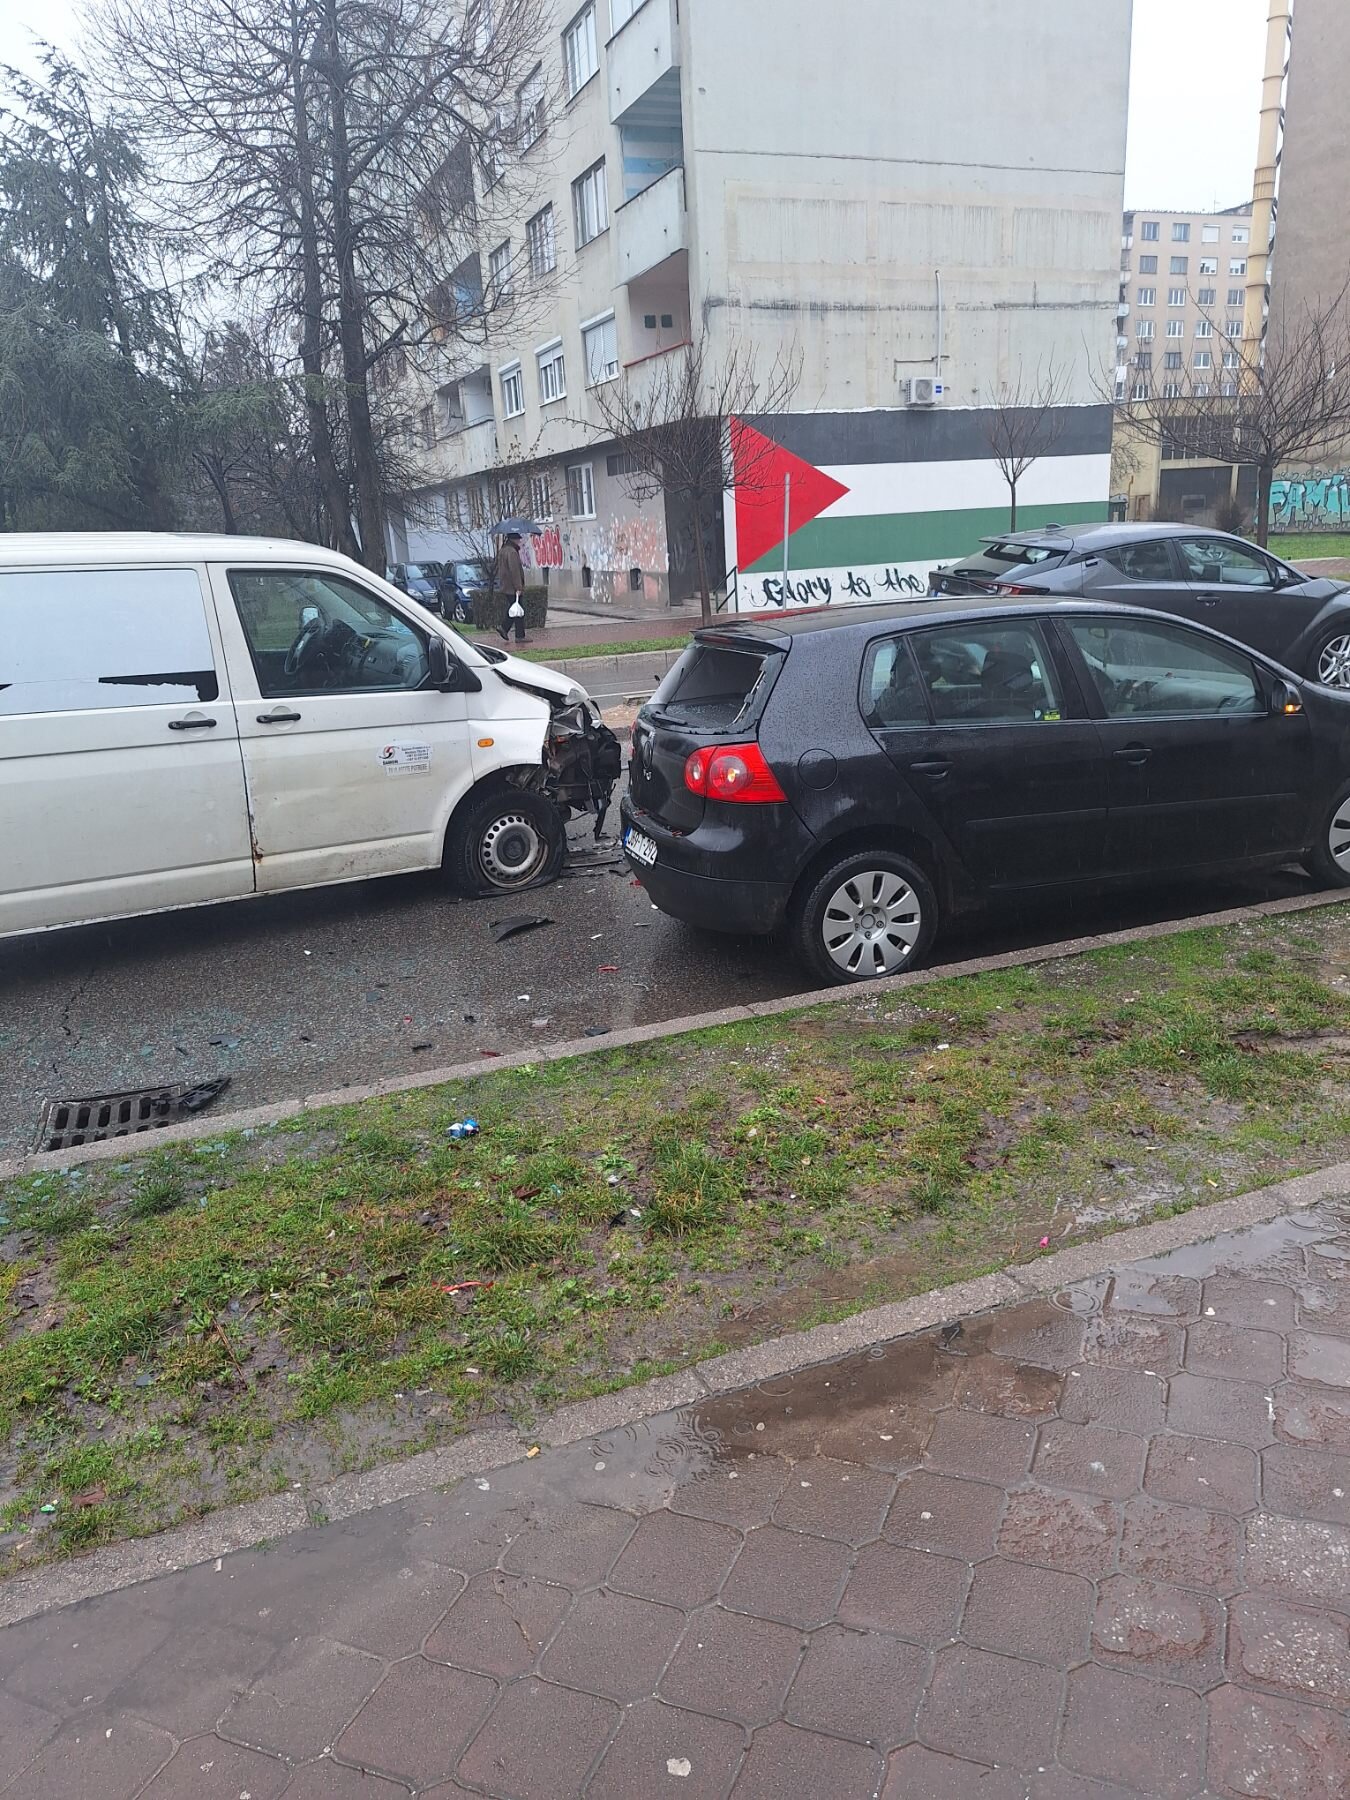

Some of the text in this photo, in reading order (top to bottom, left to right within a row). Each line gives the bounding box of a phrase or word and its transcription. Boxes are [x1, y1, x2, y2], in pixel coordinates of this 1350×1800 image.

[763, 566, 925, 606] Glory to the
